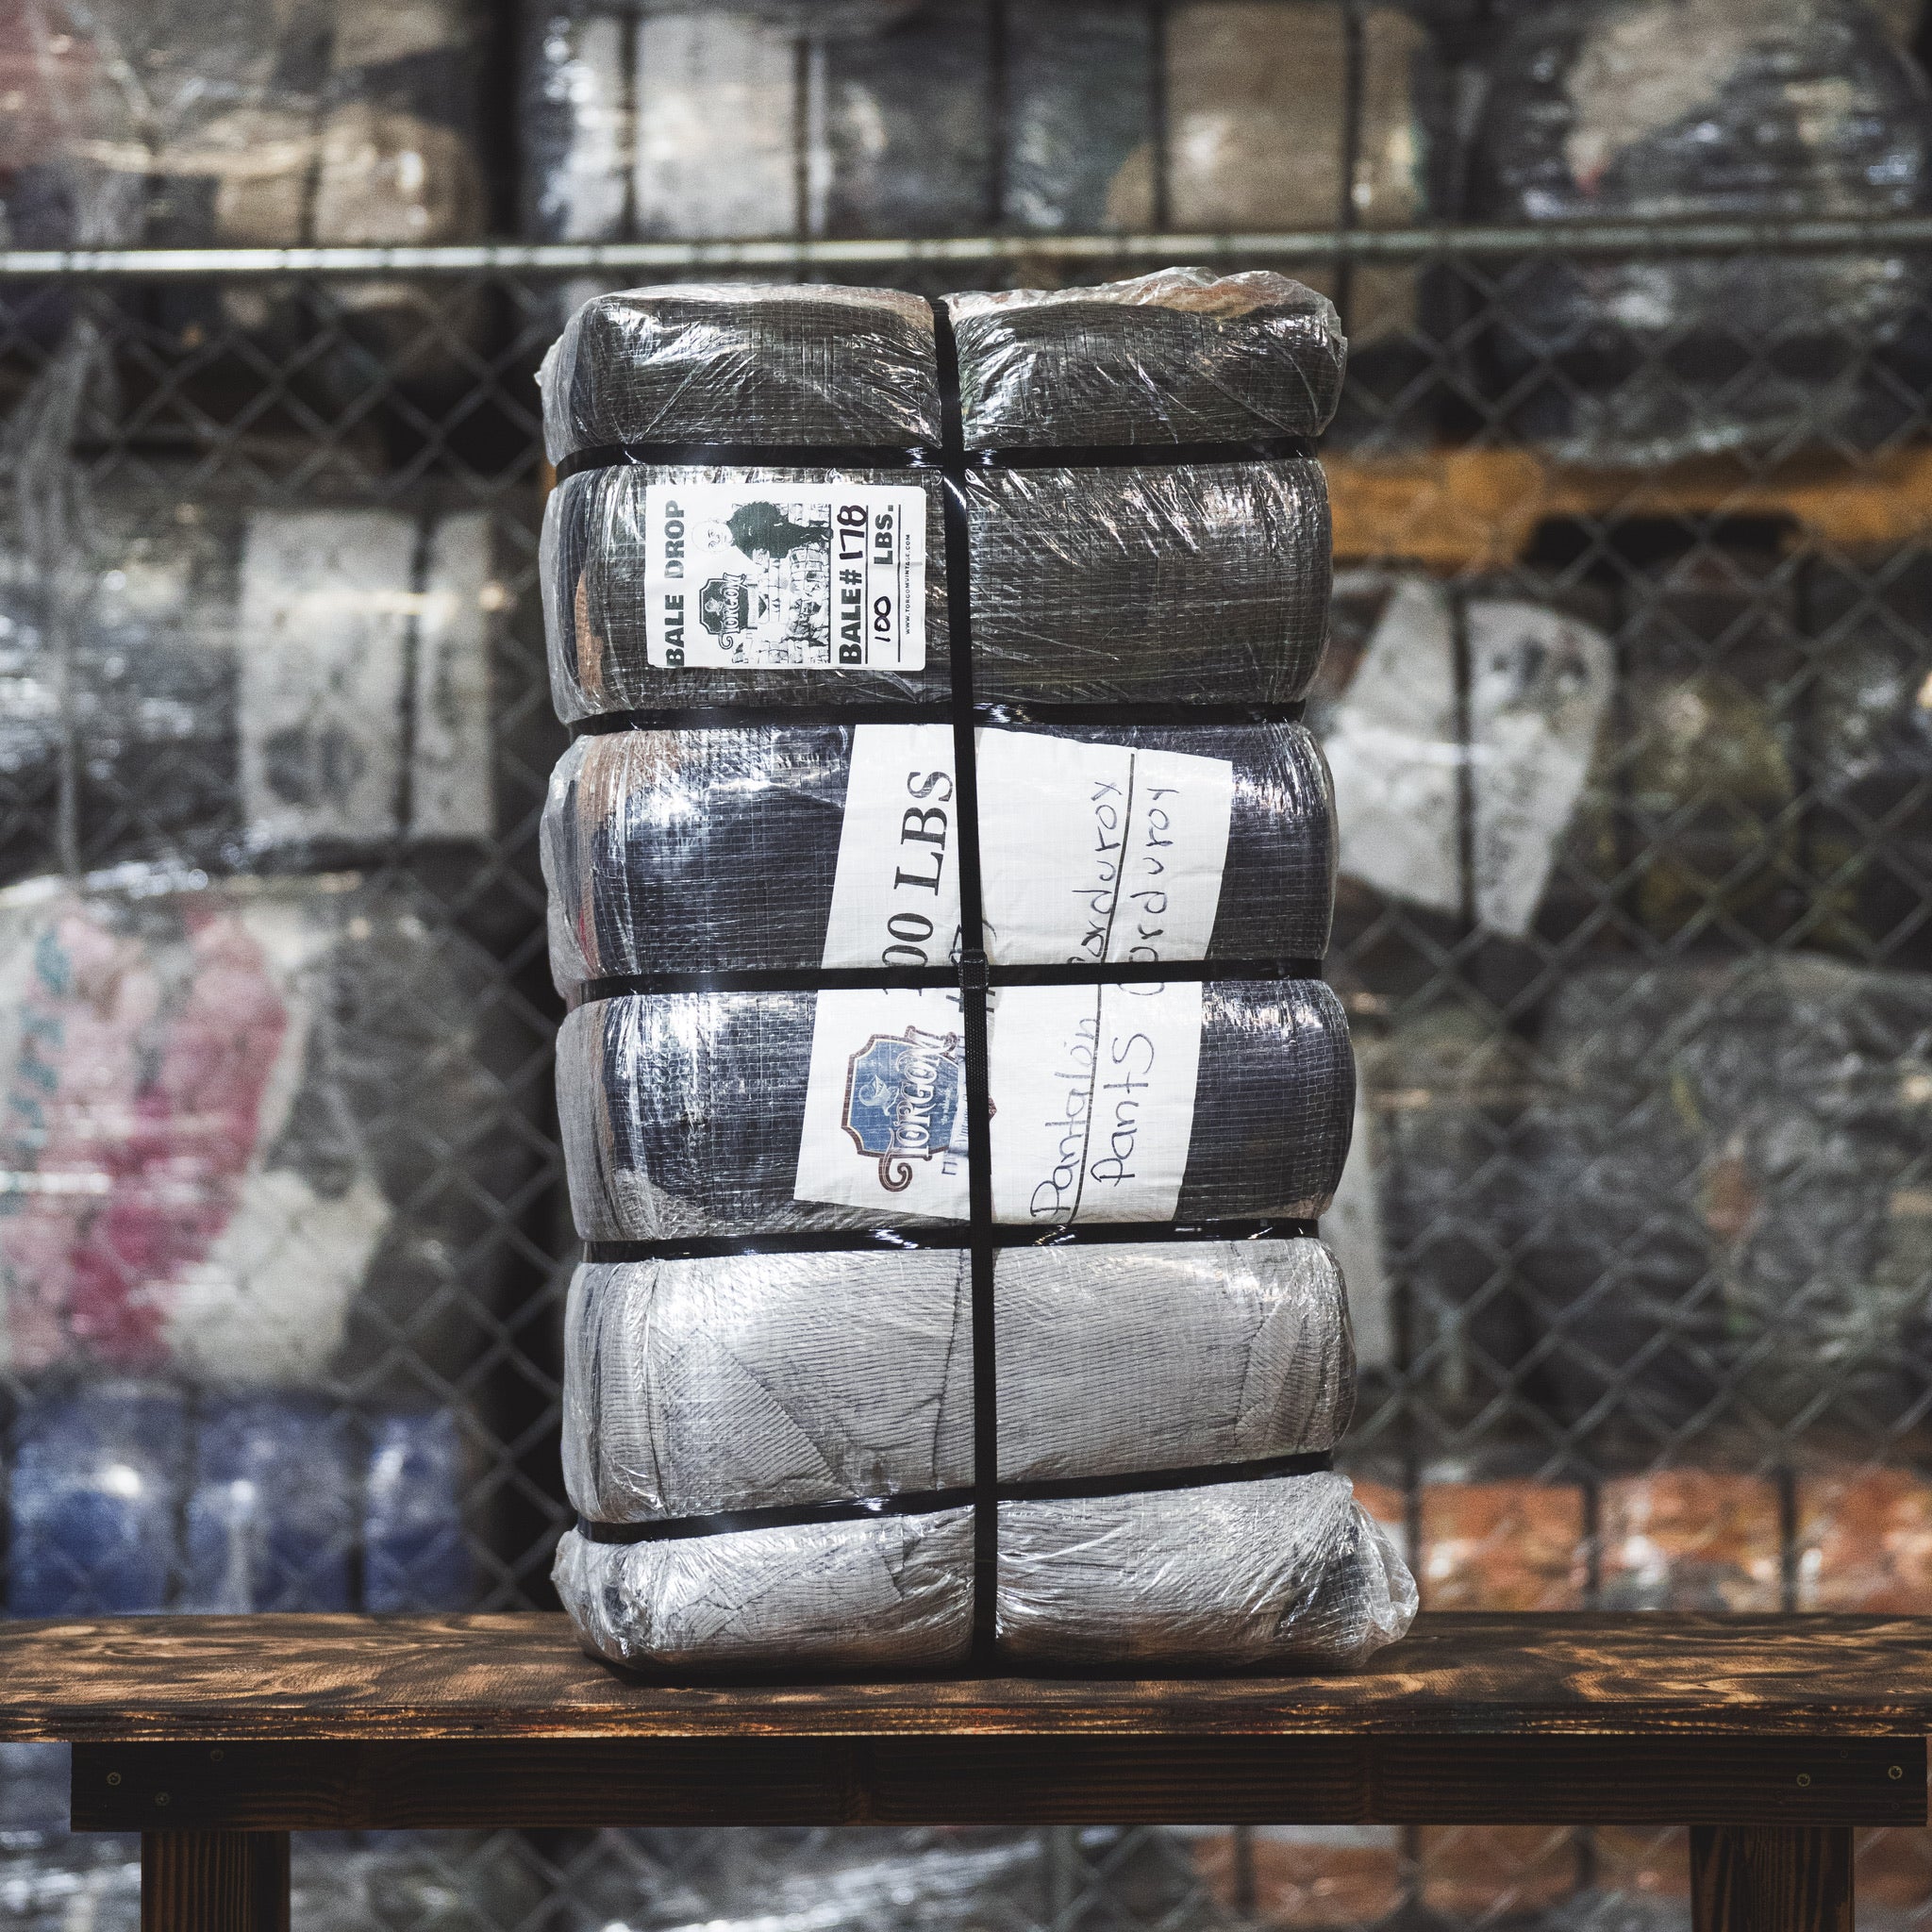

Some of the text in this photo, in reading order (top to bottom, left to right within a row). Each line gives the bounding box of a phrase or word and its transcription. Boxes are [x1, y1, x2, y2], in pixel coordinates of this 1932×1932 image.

[664, 500, 685, 665] BALE DROP
[837, 505, 868, 664] BALE# 178
[874, 505, 893, 642] 100 LBS.
[881, 771, 954, 997] 00 LBS
[1067, 781, 1123, 964] orduroy
[878, 1024, 958, 1192] TORGOM
[1091, 1033, 1155, 1188] Pants
